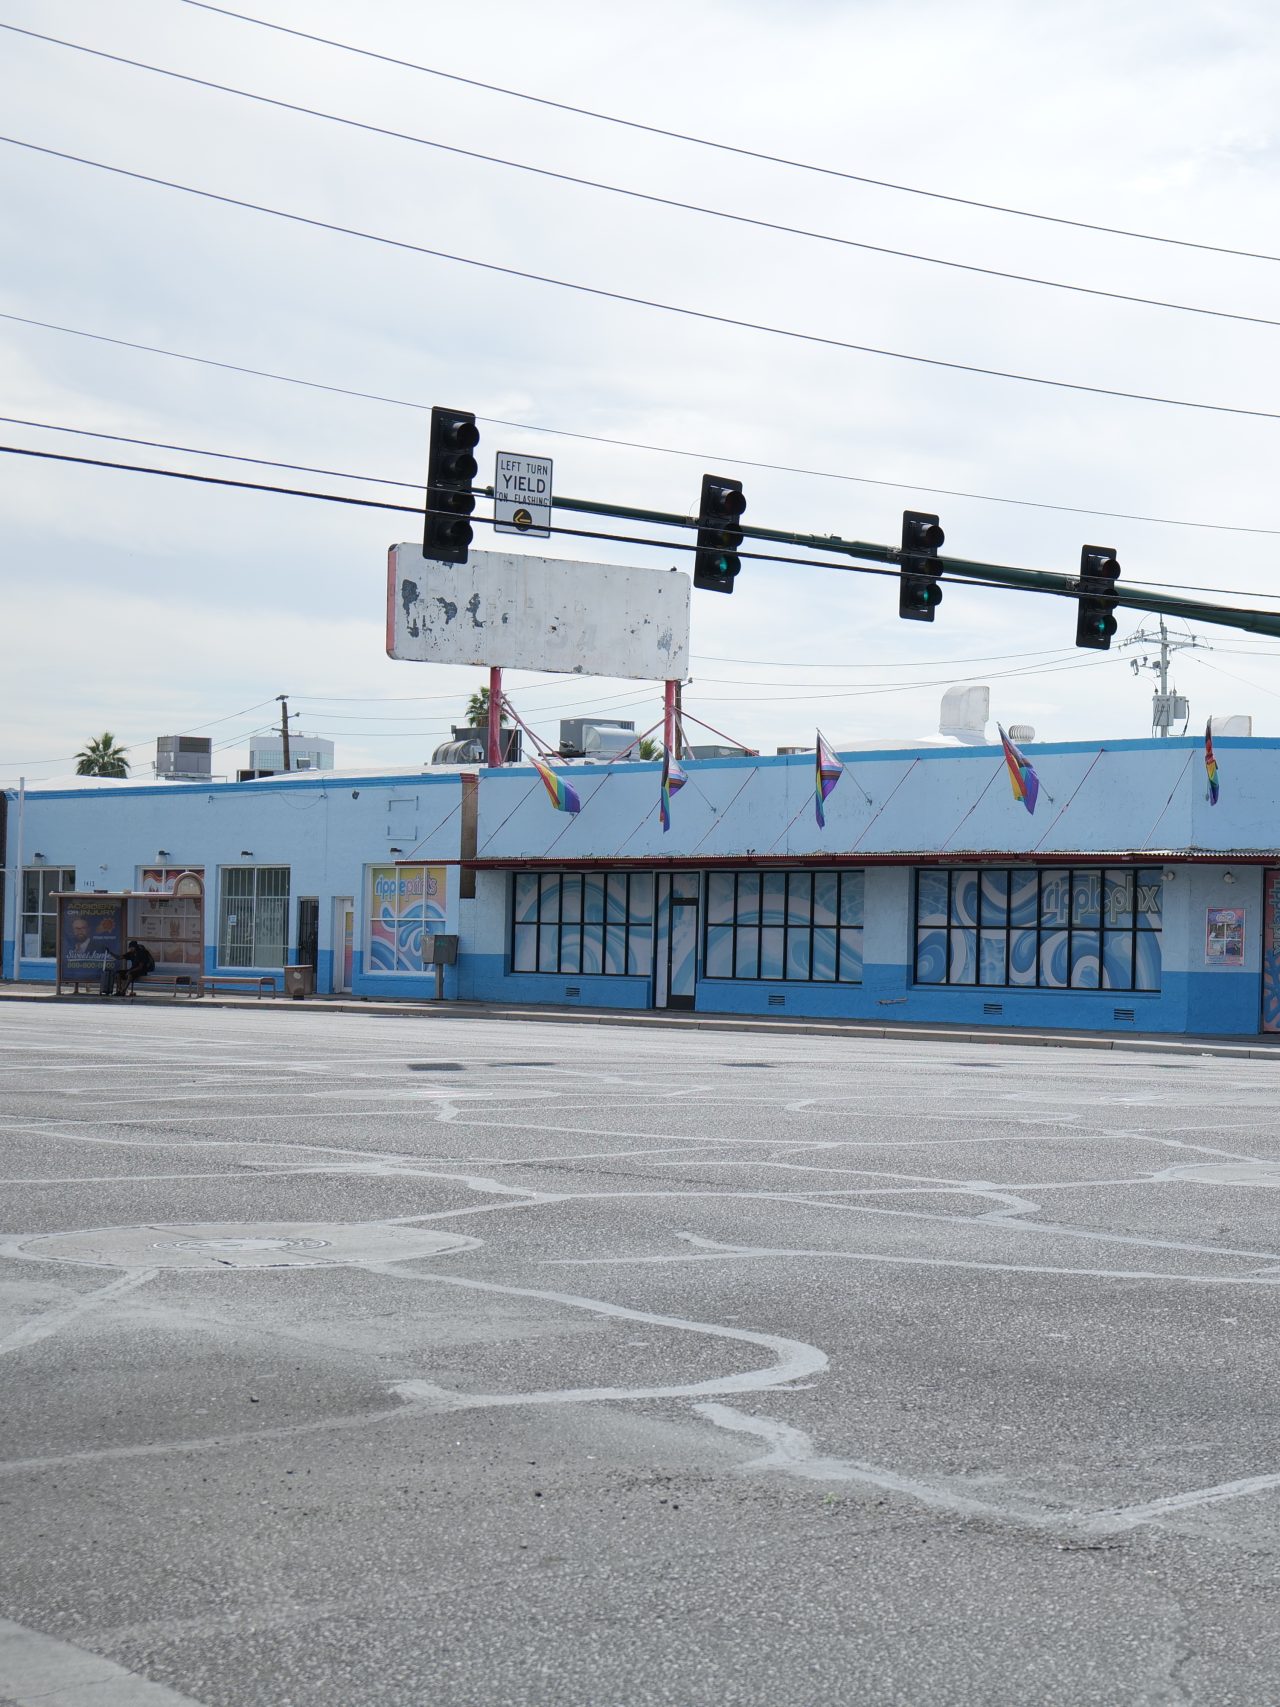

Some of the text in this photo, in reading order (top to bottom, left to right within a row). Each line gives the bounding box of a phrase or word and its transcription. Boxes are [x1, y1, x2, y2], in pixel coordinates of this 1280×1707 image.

[500, 459, 548, 476] LEFT TURN
[503, 473, 546, 494] YIELD
